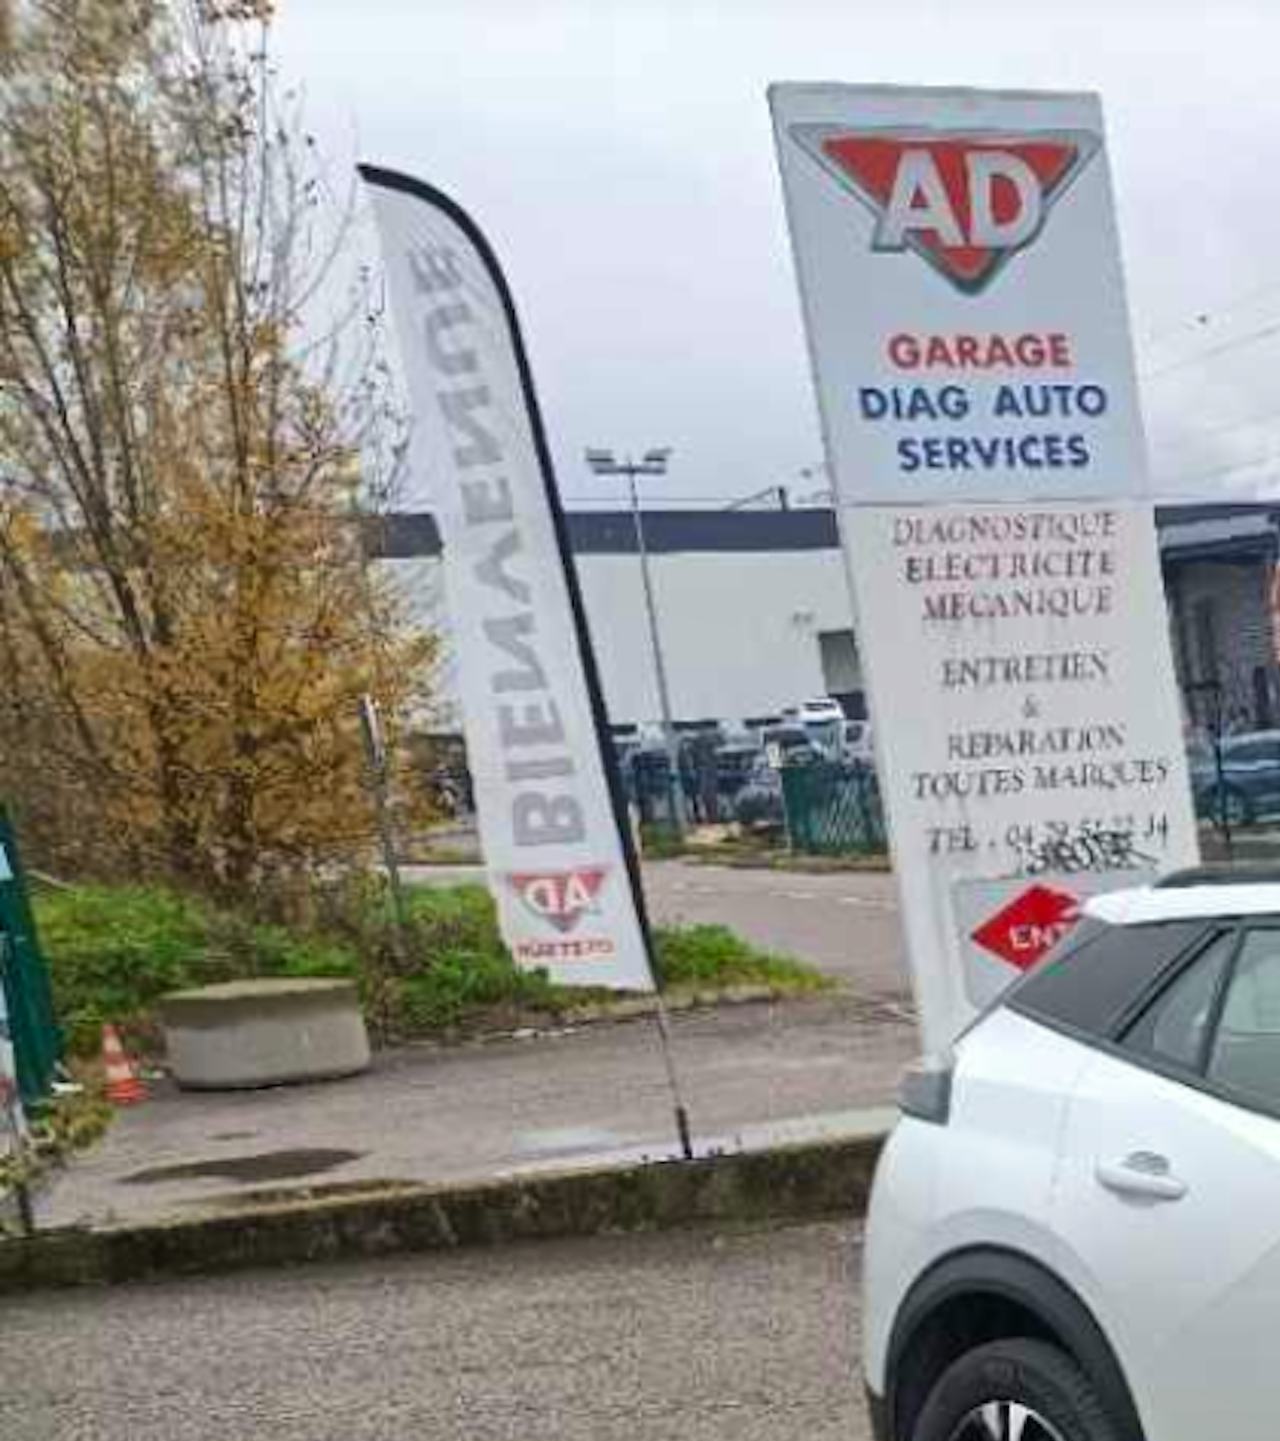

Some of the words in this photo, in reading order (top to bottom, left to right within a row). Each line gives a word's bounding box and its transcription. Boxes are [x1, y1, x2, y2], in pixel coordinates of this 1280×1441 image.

[876, 147, 1042, 248] AD
[888, 333, 1071, 370] GARAGE
[859, 384, 970, 420] DIAG
[993, 384, 1107, 418] AUTO
[897, 434, 1090, 472] SERVICES
[893, 512, 1116, 546] DIAGNOSTIQUE
[941, 652, 1109, 687] ENTRETIEN
[914, 768, 1025, 799] TOUTES
[1032, 759, 1169, 789] MARQUES
